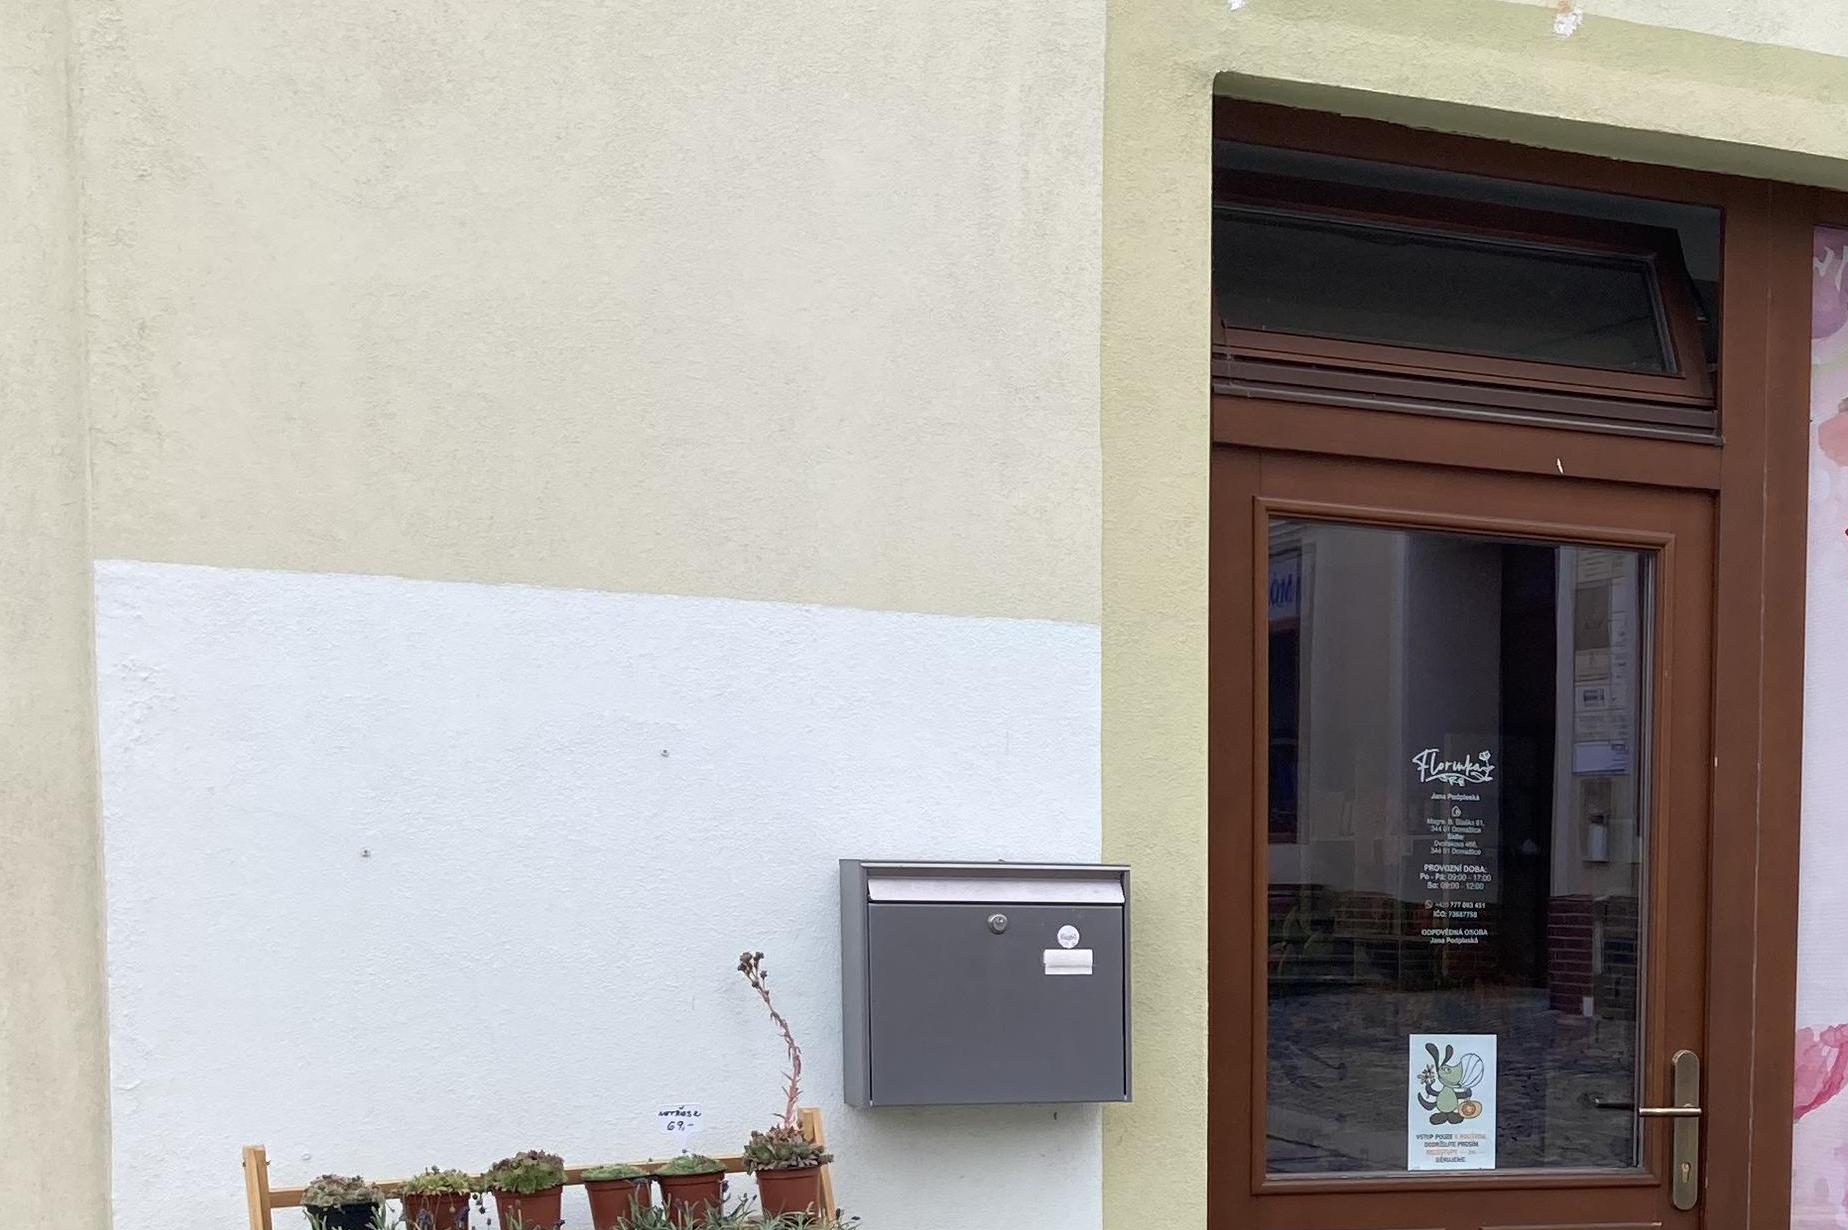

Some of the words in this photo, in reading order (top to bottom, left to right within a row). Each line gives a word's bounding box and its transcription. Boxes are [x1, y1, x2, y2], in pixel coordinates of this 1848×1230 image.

[1412, 748, 1481, 783] Florinka
[1423, 863, 1462, 872] PROVOZNÍ
[1420, 872, 1430, 880] Po
